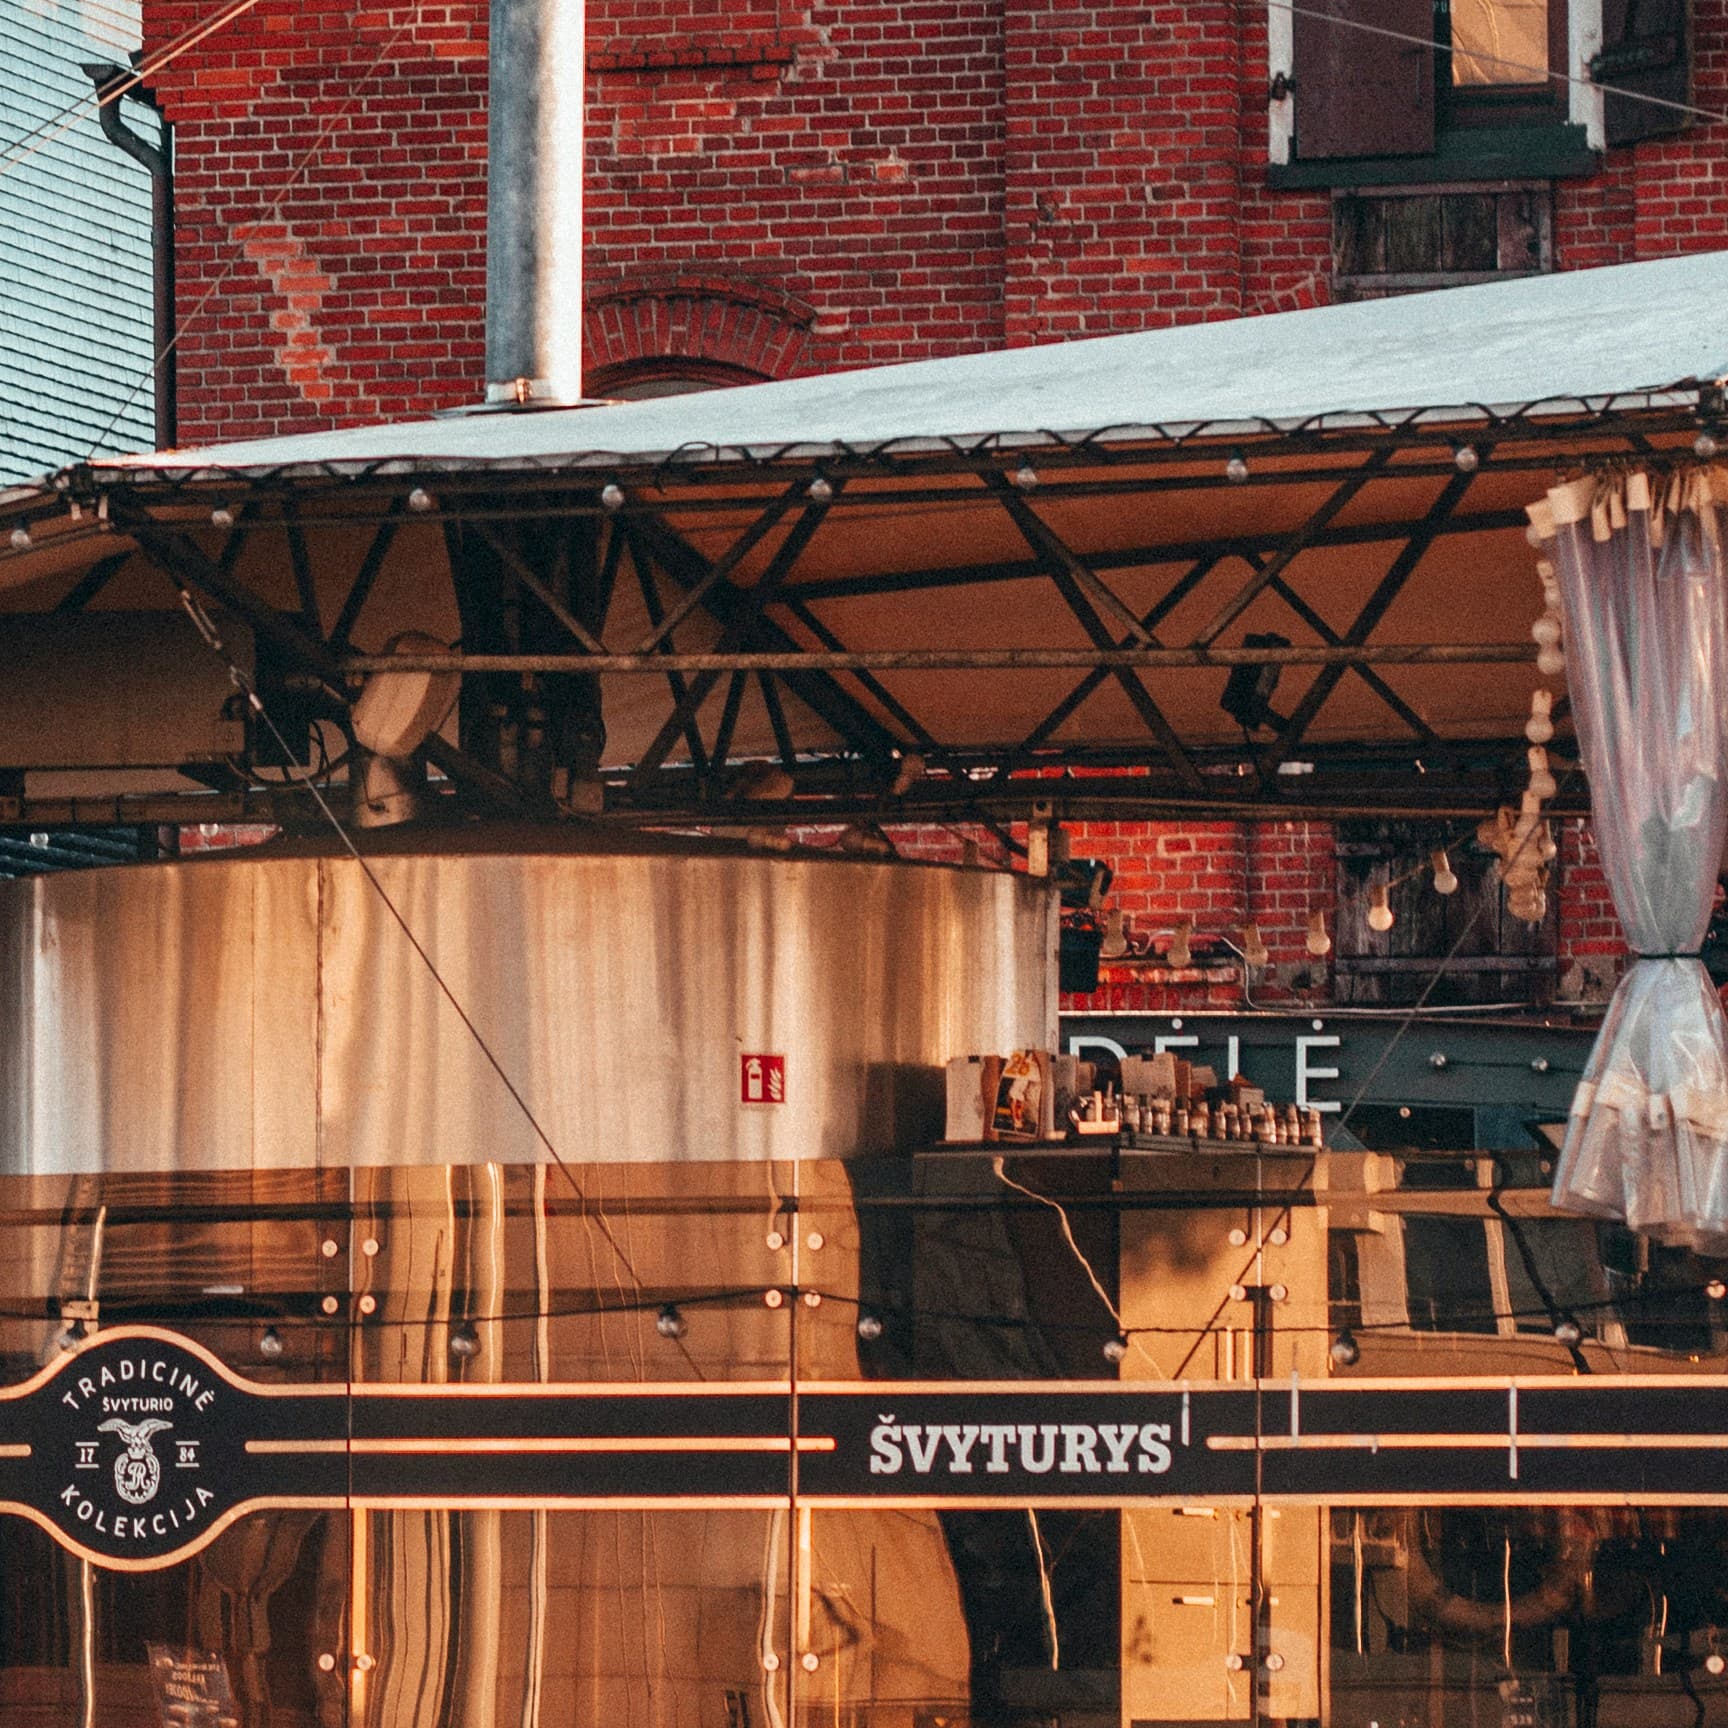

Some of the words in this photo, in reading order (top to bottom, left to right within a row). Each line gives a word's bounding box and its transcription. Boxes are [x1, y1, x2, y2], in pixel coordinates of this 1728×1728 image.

[62, 1359, 215, 1412] TRADICINĖ
[102, 1397, 173, 1412] ŠVYTURIO
[80, 1447, 94, 1463] 17
[179, 1446, 196, 1462] 84
[869, 1414, 1172, 1473] ŠVYTURYS
[60, 1484, 214, 1538] KOLEKCIJA
